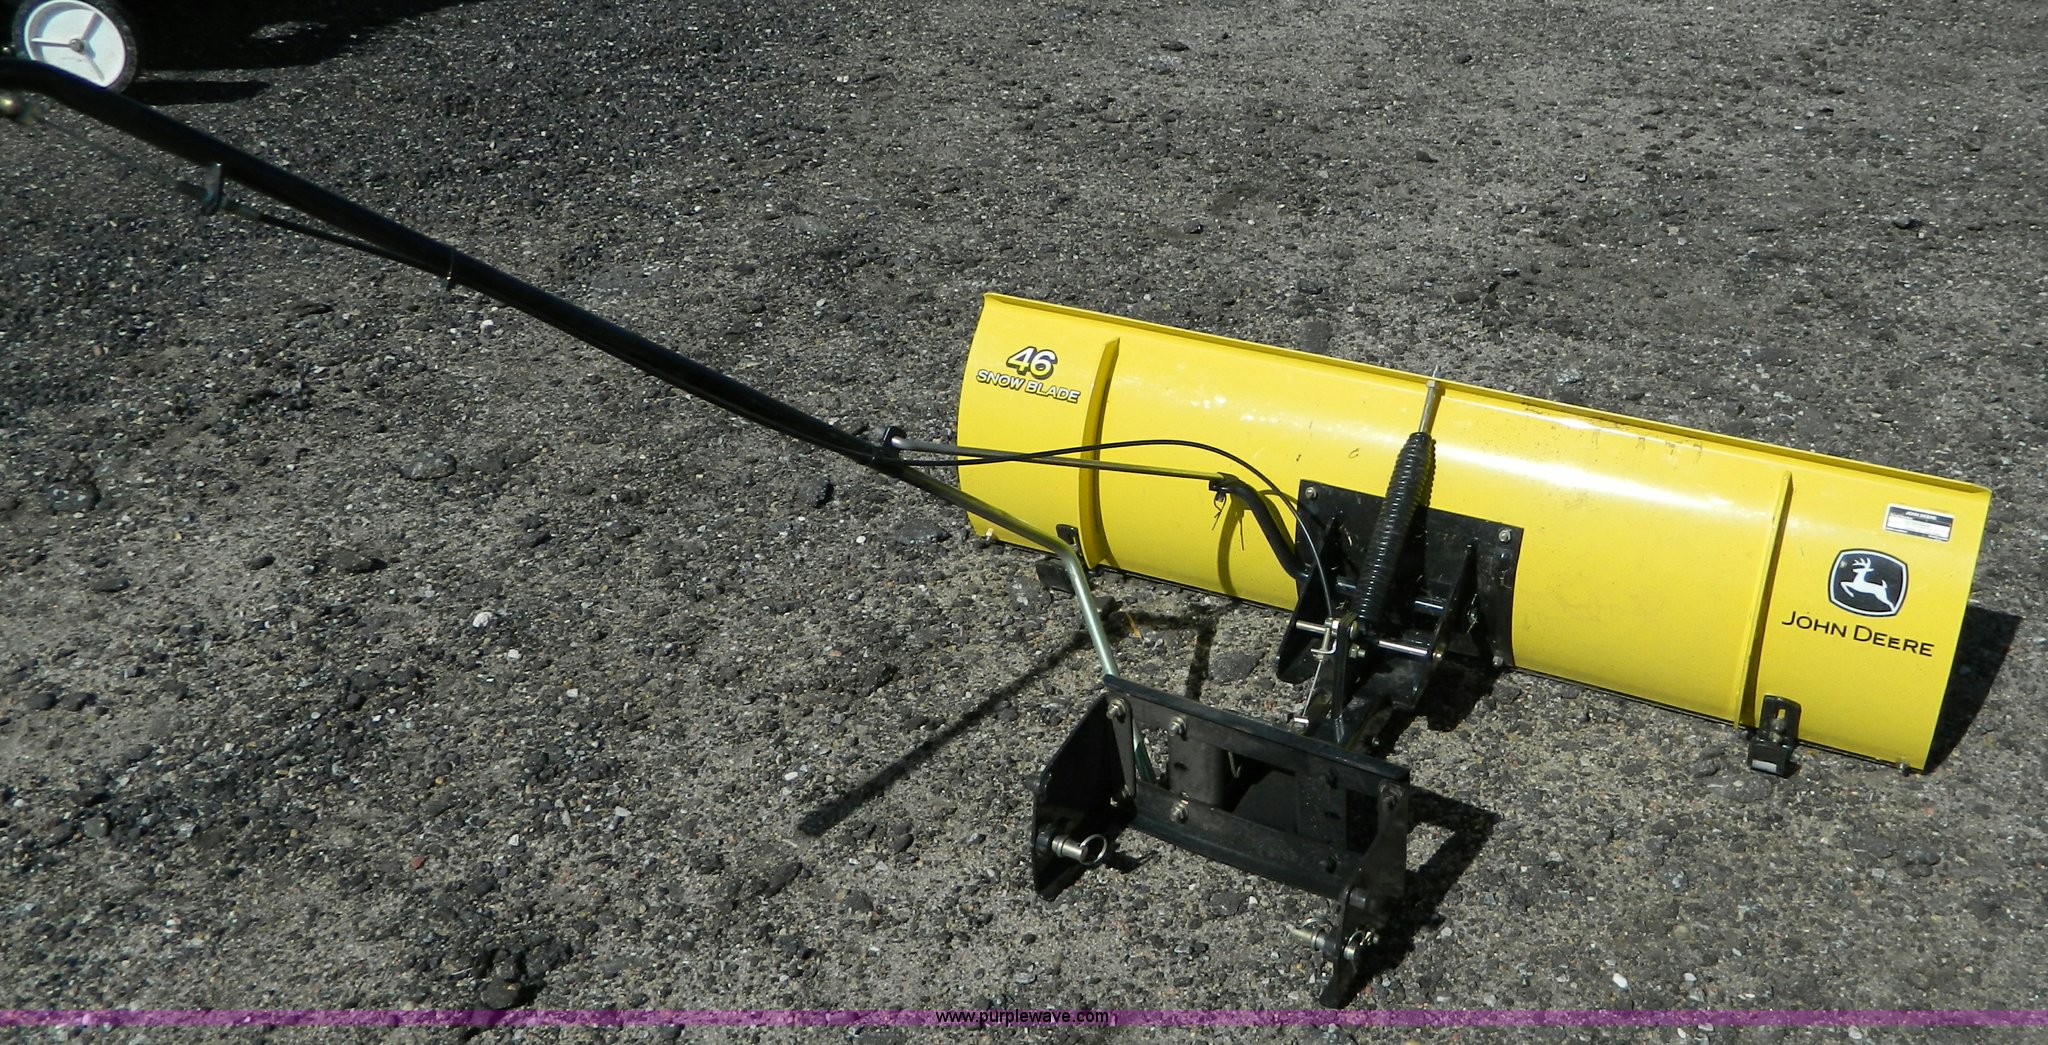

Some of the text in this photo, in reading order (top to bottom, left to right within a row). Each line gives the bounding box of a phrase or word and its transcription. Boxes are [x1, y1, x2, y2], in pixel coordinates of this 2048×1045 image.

[1006, 346, 1058, 380] 46
[976, 369, 1081, 403] SNOW BLADE
[1782, 611, 1935, 657] JOHN DEERE
